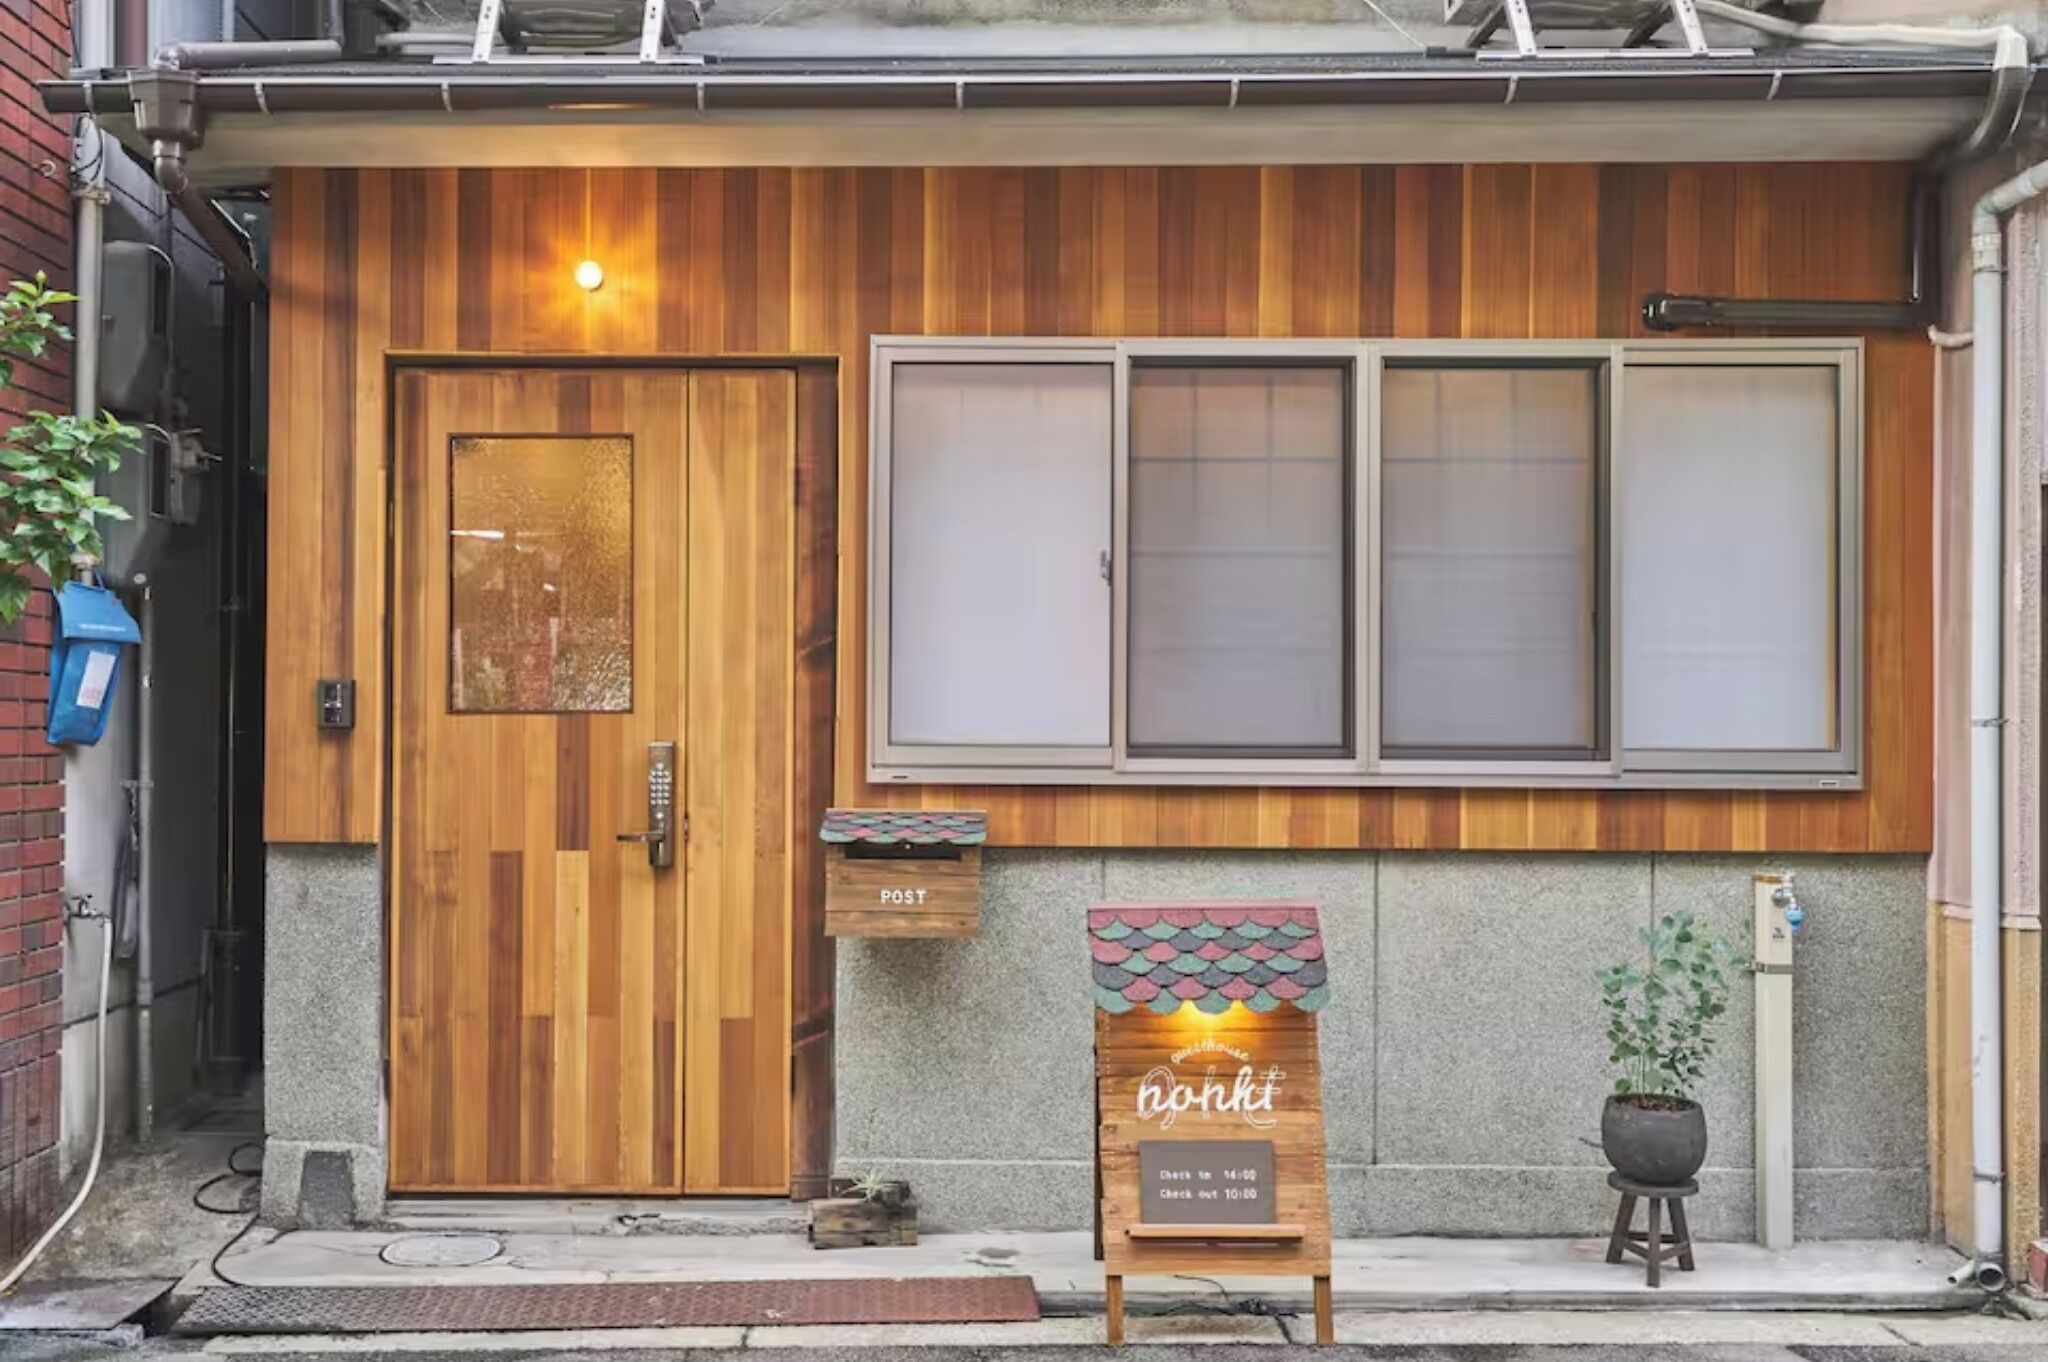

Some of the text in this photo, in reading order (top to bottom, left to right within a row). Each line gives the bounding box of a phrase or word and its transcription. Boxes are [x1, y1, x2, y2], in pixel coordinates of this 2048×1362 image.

[880, 889, 927, 905] POST
[1160, 1169, 1191, 1181] Check
[1198, 1169, 1212, 1181] in
[1160, 1187, 1257, 1201] Check out 10:00
